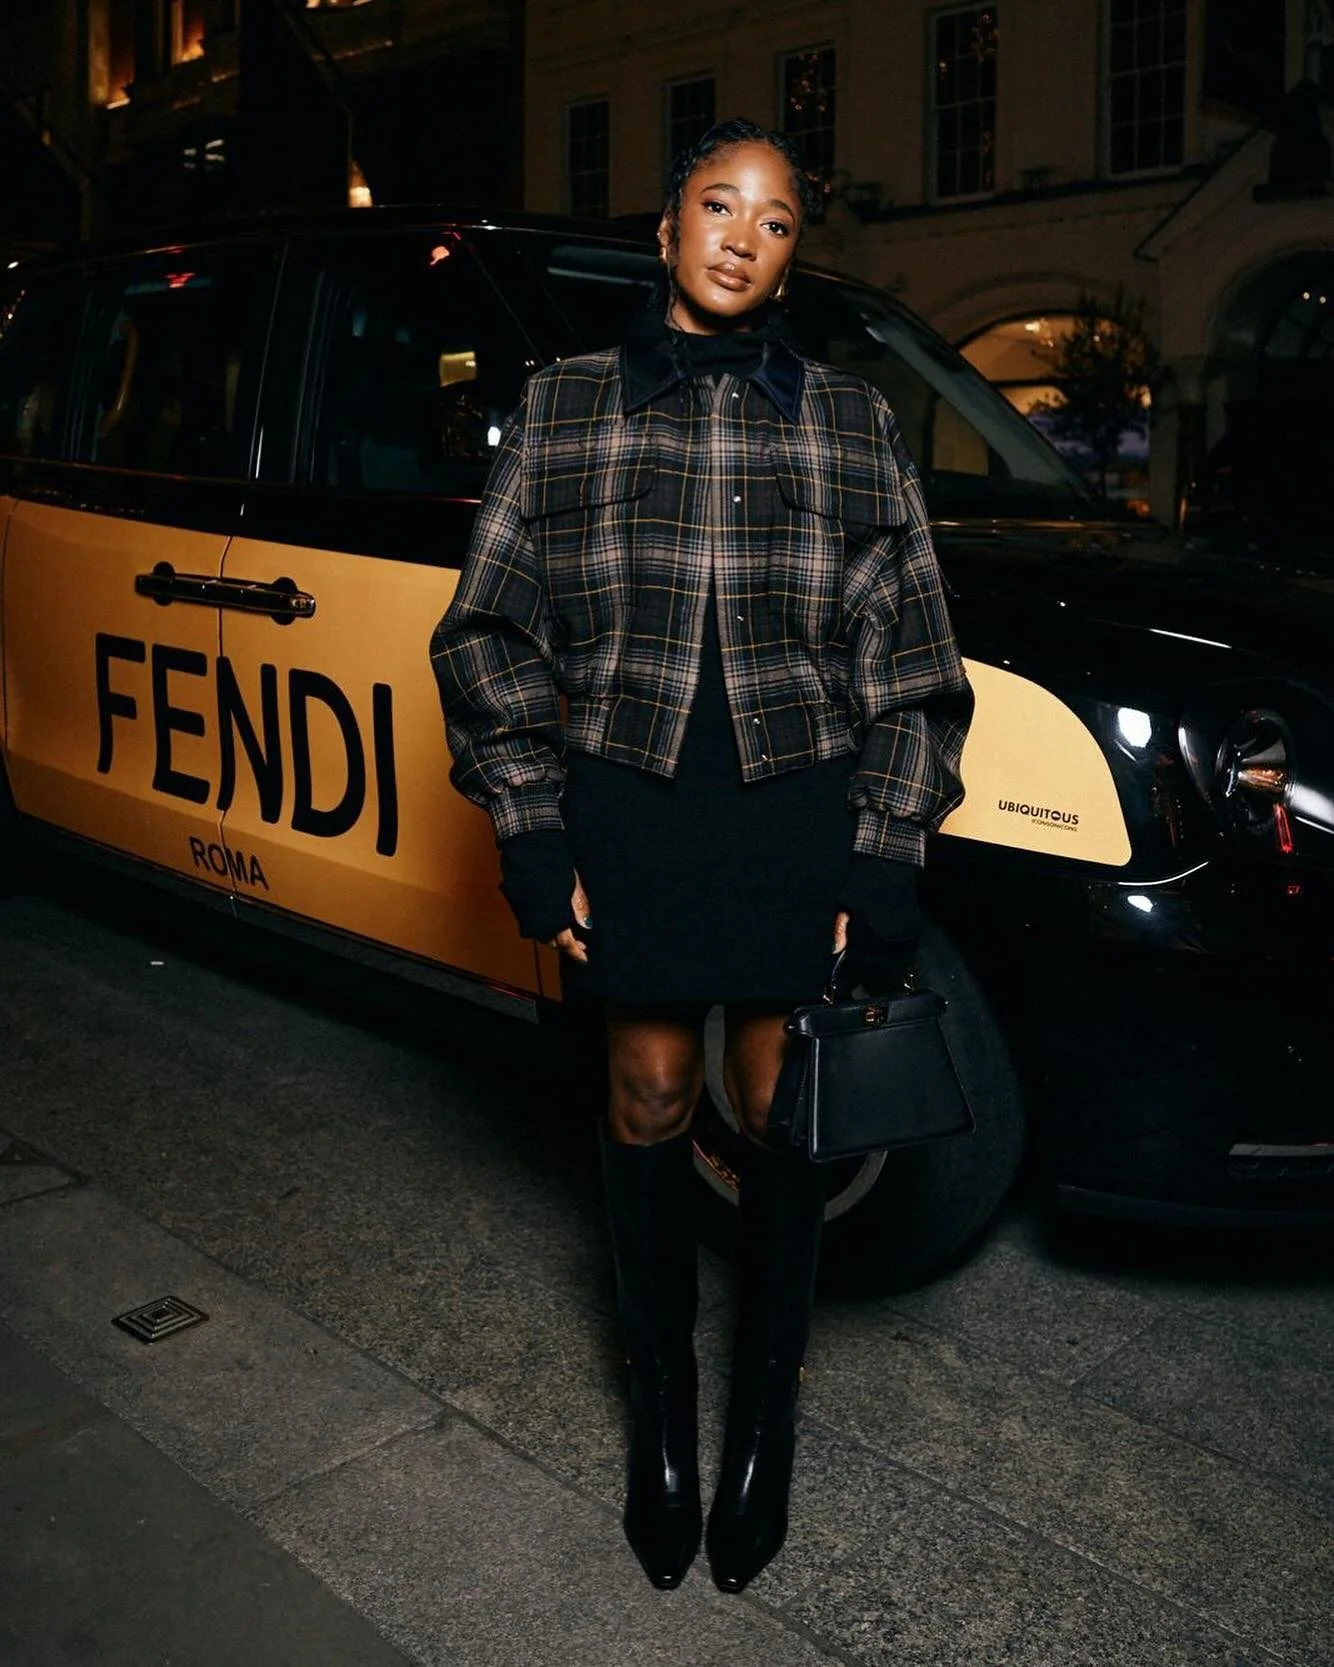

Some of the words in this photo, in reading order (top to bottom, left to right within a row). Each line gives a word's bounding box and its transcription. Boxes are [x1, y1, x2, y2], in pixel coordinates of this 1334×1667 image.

[95, 632, 398, 857] FENDI
[998, 799, 1079, 825] UBIQUITOUS
[190, 836, 269, 891] ROMA
